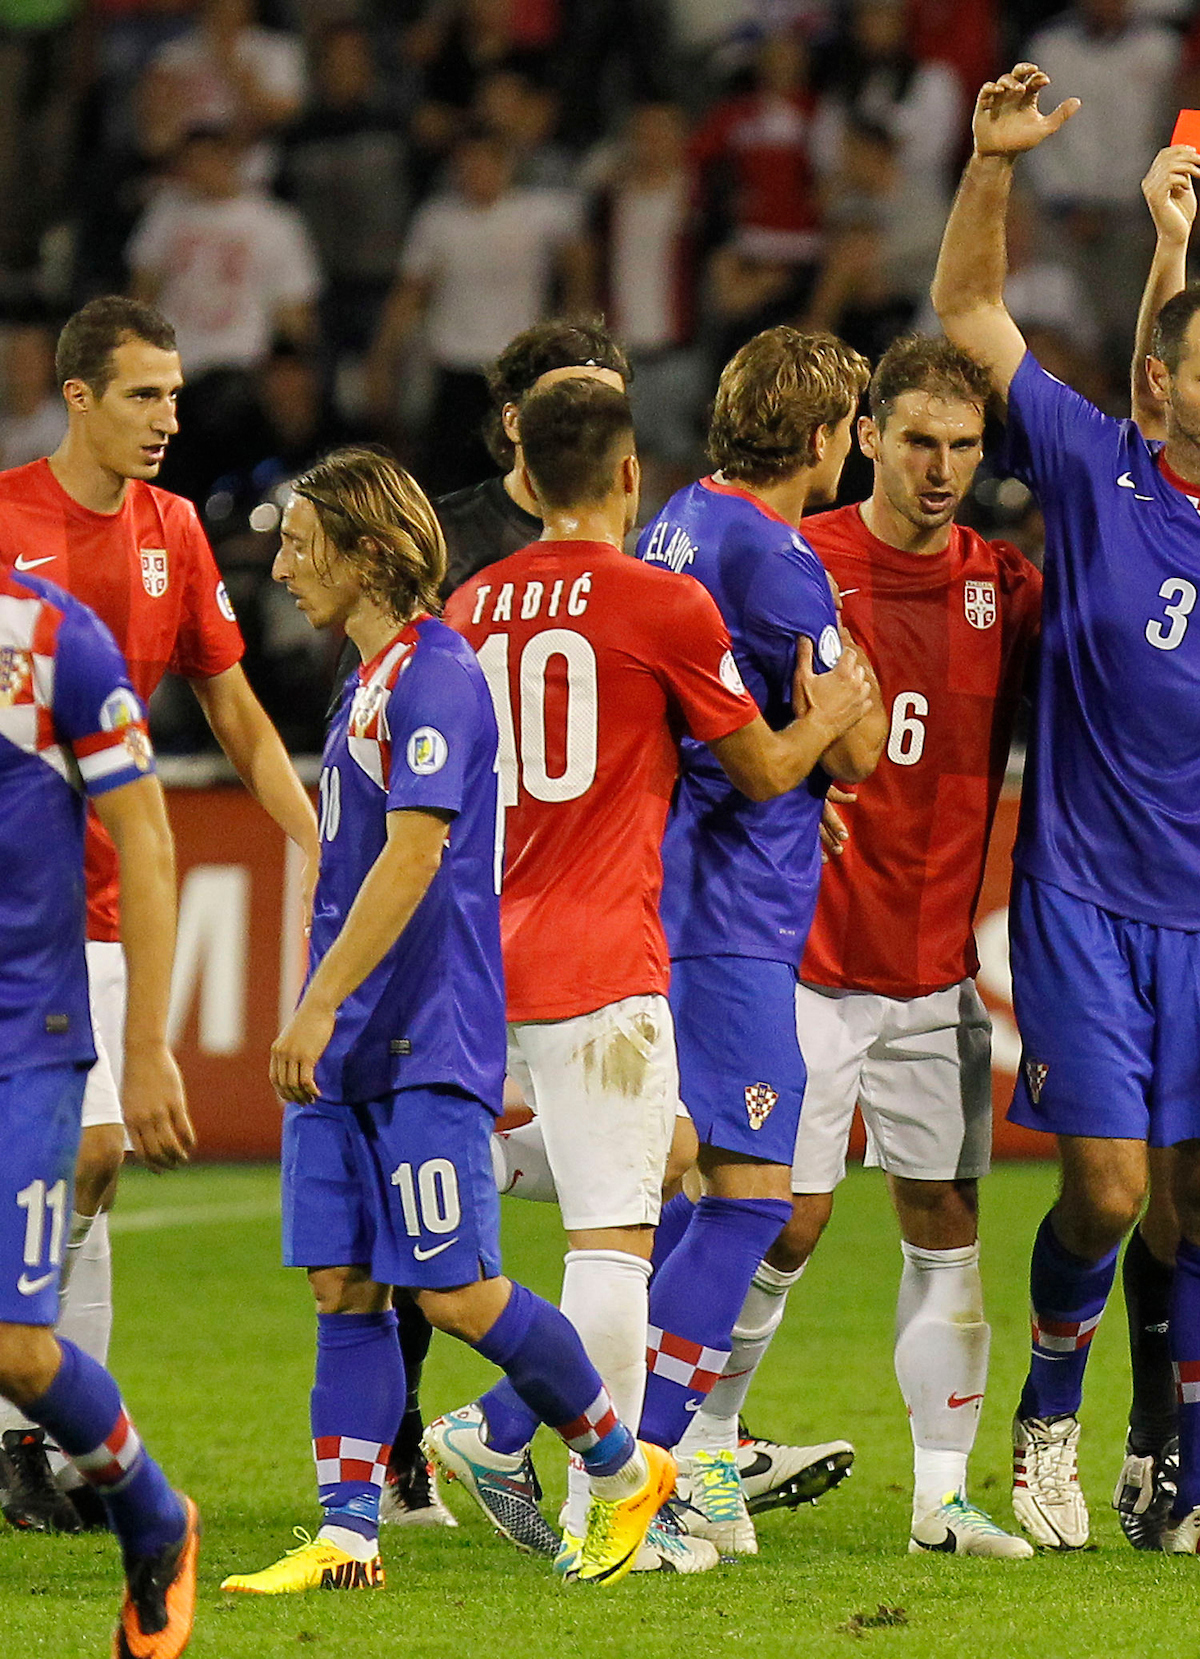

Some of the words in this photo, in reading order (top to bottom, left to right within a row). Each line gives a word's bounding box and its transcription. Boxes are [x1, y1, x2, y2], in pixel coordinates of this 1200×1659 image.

[642, 522, 699, 574] ELAVIĆ
[471, 572, 593, 625] TADIĆ
[1145, 577, 1197, 650] 3
[476, 628, 598, 807] 10
[887, 691, 929, 766] 6
[16, 1179, 67, 1267] 11
[391, 1158, 461, 1237] 10
